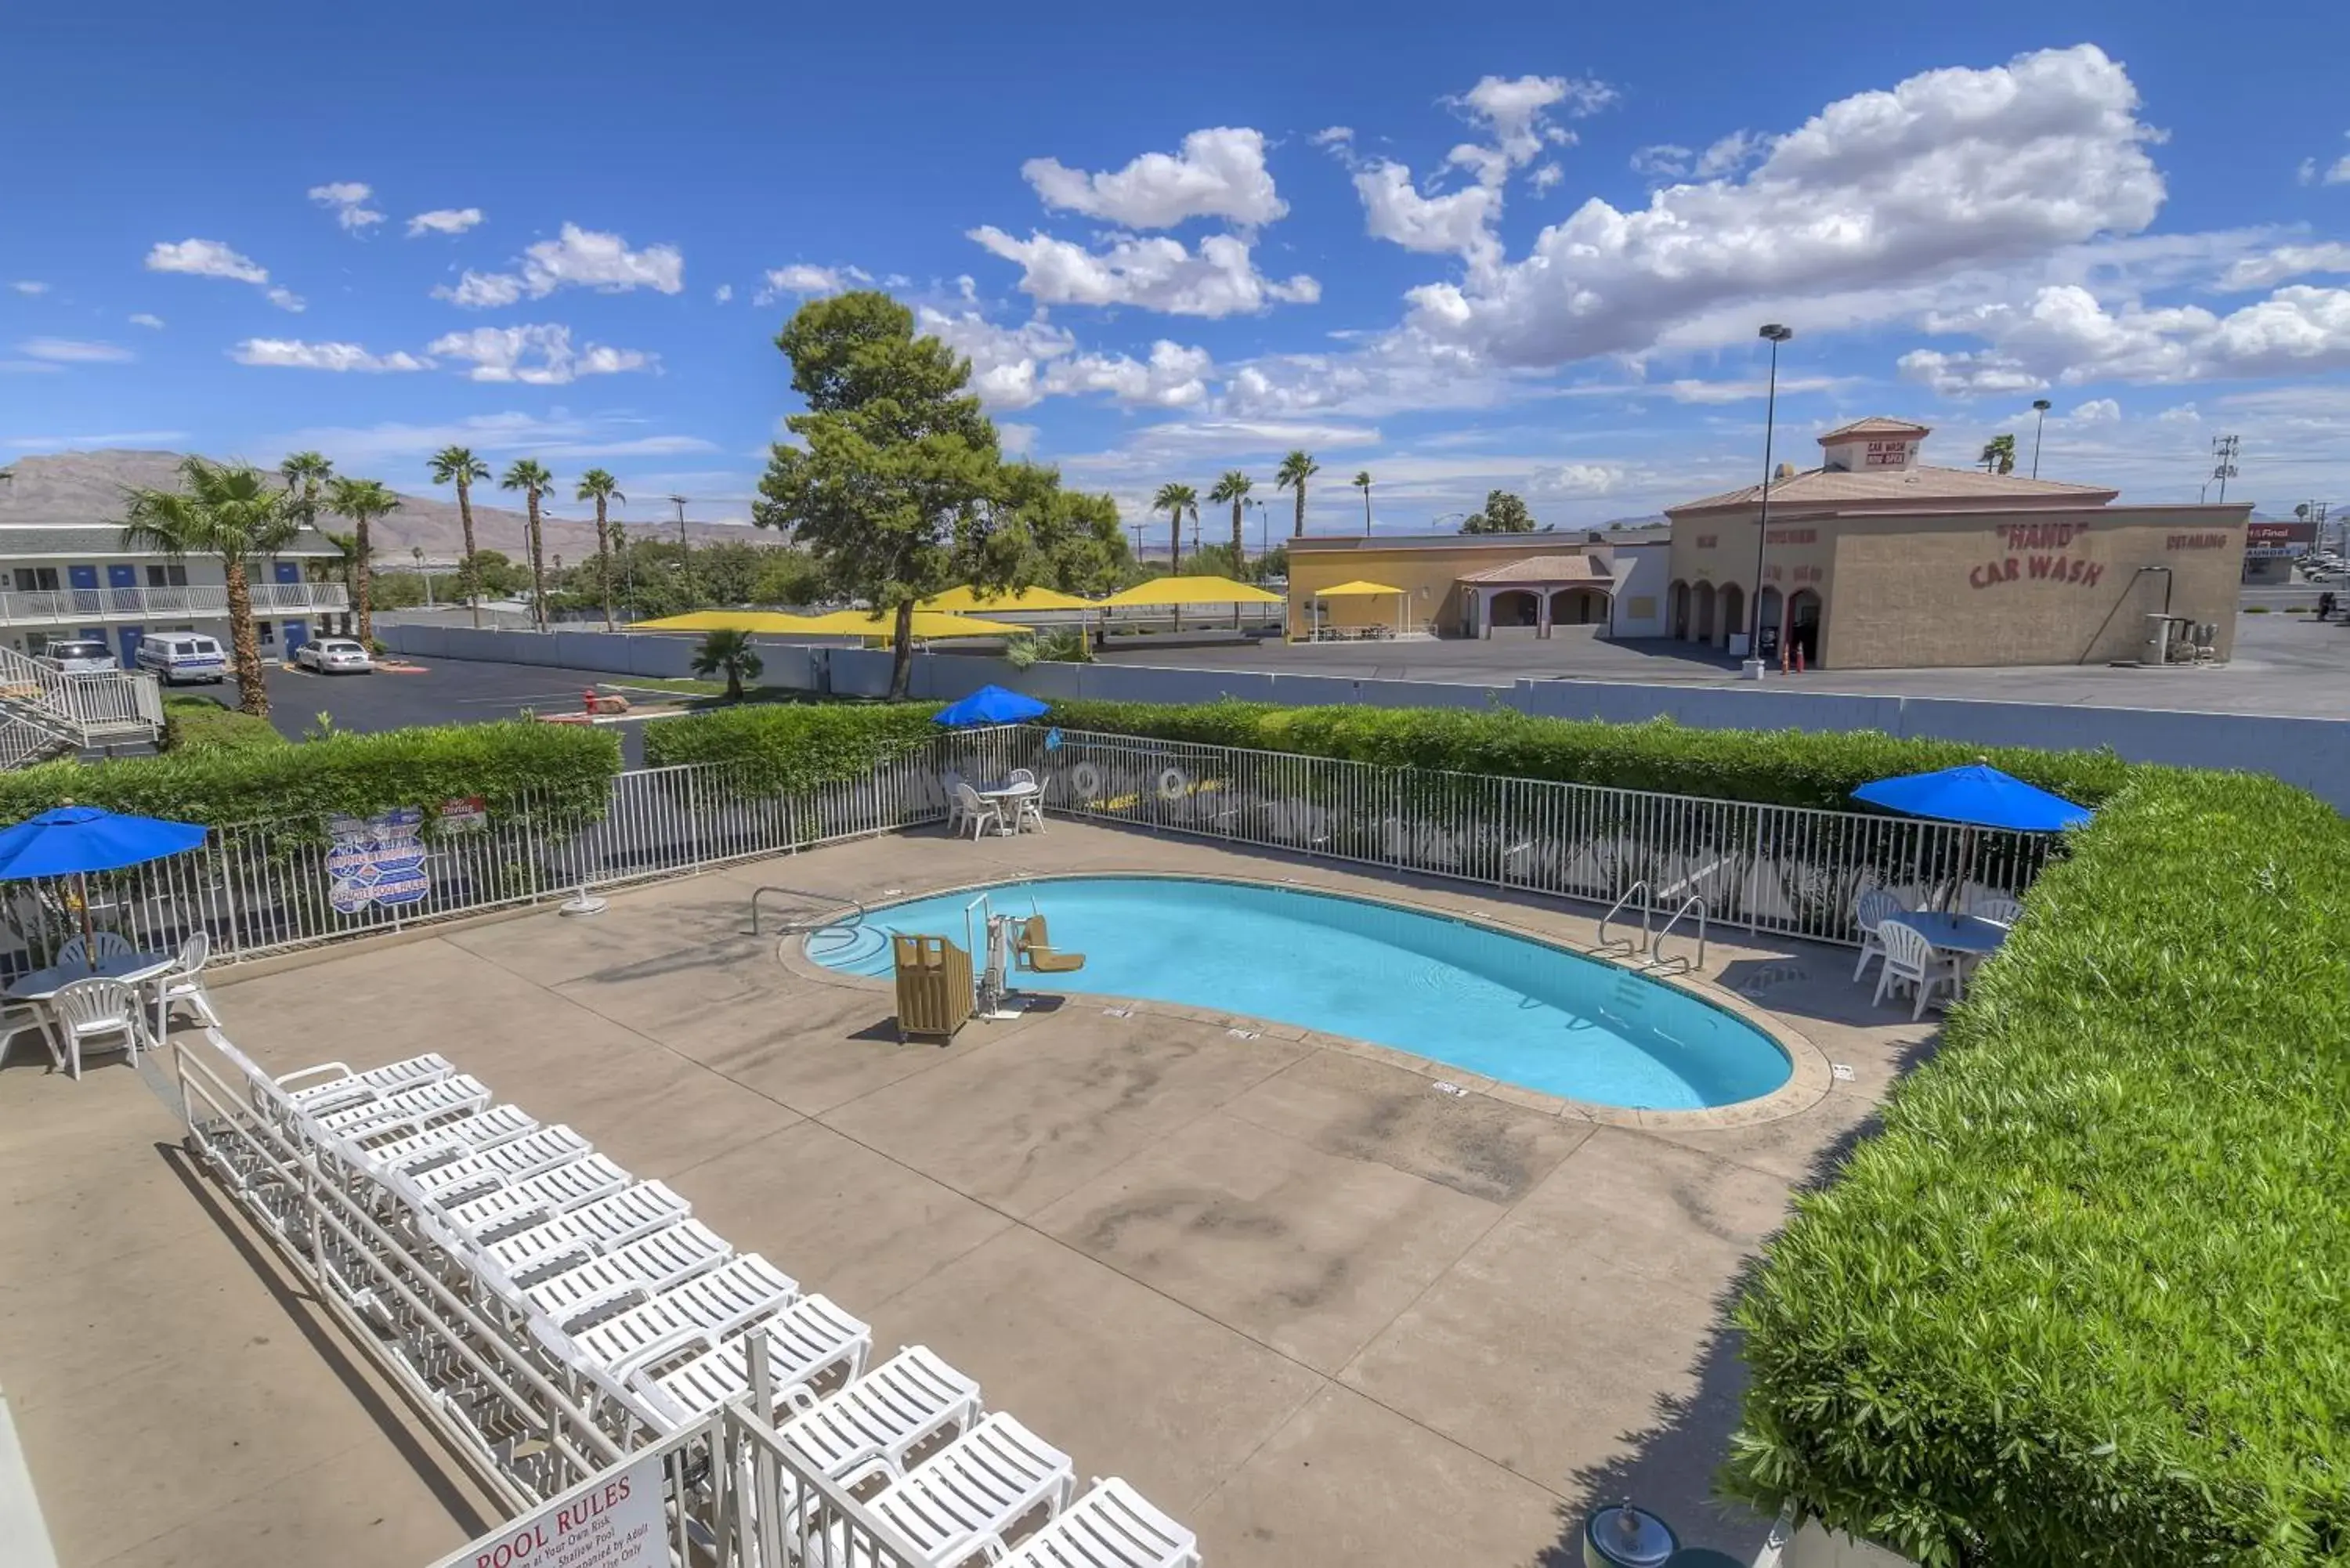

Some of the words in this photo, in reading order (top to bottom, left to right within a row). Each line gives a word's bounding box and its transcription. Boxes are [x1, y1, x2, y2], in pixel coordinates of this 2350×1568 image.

[2167, 533, 2227, 551] DETAILING
[1969, 557, 2020, 589] CAR
[2028, 555, 2104, 588] WASH
[476, 1523, 548, 1568] POOL
[556, 1476, 631, 1535] RULES
[545, 1542, 566, 1559] Your
[568, 1529, 588, 1545] Own
[591, 1516, 610, 1533] Risk
[613, 1540, 624, 1551] by
[626, 1523, 649, 1544] Adult
[559, 1541, 593, 1566] Shallow
[595, 1526, 615, 1546] Pool
[622, 1544, 642, 1560] Only
